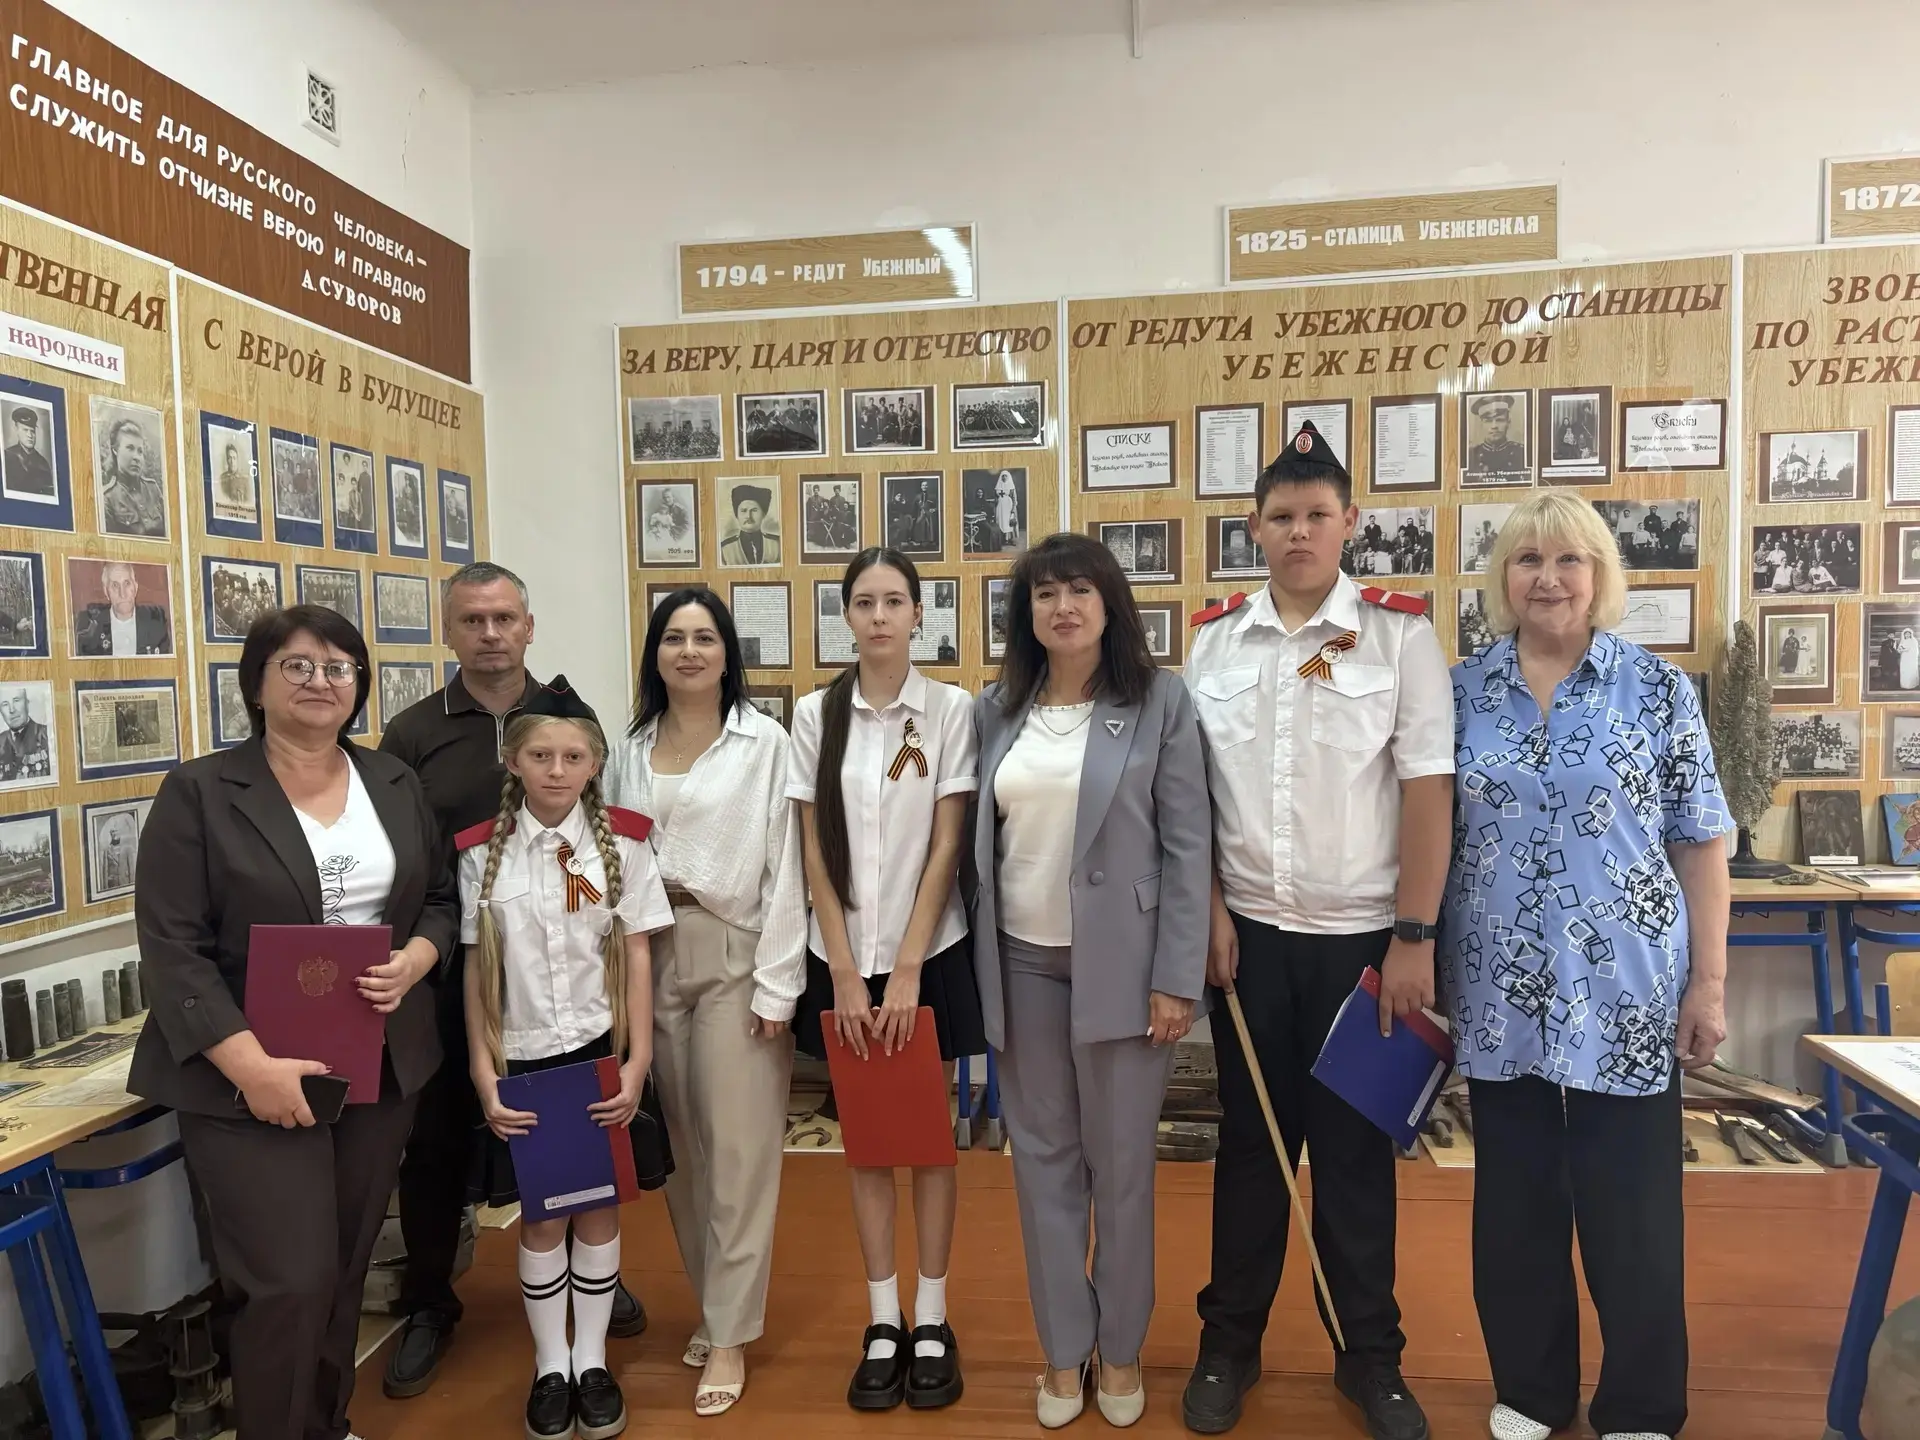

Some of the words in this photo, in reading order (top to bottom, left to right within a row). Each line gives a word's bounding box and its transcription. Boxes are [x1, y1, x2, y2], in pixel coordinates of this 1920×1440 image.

[11, 33, 142, 124] ГЛАВНОЕ
[157, 114, 208, 158] ДЛЯ
[217, 145, 316, 216] РУССКОГО
[9, 83, 146, 167] СЛУЖИТЬ
[159, 156, 253, 221] ОТЧИЗНЕ
[263, 209, 324, 256] ВЕРОЮ
[335, 247, 346, 268] И
[352, 259, 426, 304] ПРАВДОЮ
[1840, 183, 1920, 211] 1872
[1419, 215, 1539, 240] УБЕЖЕНСКАЯ
[697, 264, 768, 288] 1794
[793, 263, 846, 284] РЕДУТ
[1072, 323, 1116, 348] ОТ
[1125, 315, 1253, 351] РЕДУТА
[1274, 301, 1466, 340] УБЕЖНОГО
[1478, 297, 1528, 331] ДО
[1539, 284, 1727, 321] СТАНИЦЫ
[1751, 319, 1810, 350] ПО
[8, 327, 118, 372] народная
[204, 318, 223, 350] С
[237, 329, 326, 386] ВЕРОЙ
[339, 365, 353, 393] В
[361, 374, 461, 430] БУДУЩЕЕ
[622, 349, 657, 375] ЗА
[663, 345, 741, 375] ВЕРУ,
[751, 340, 838, 372] ЦАРЯ
[841, 338, 869, 364] И
[873, 326, 1052, 363] ОТЕЧЕСТВО
[1222, 331, 1552, 380] УБЕЖЕНСКОЙ
